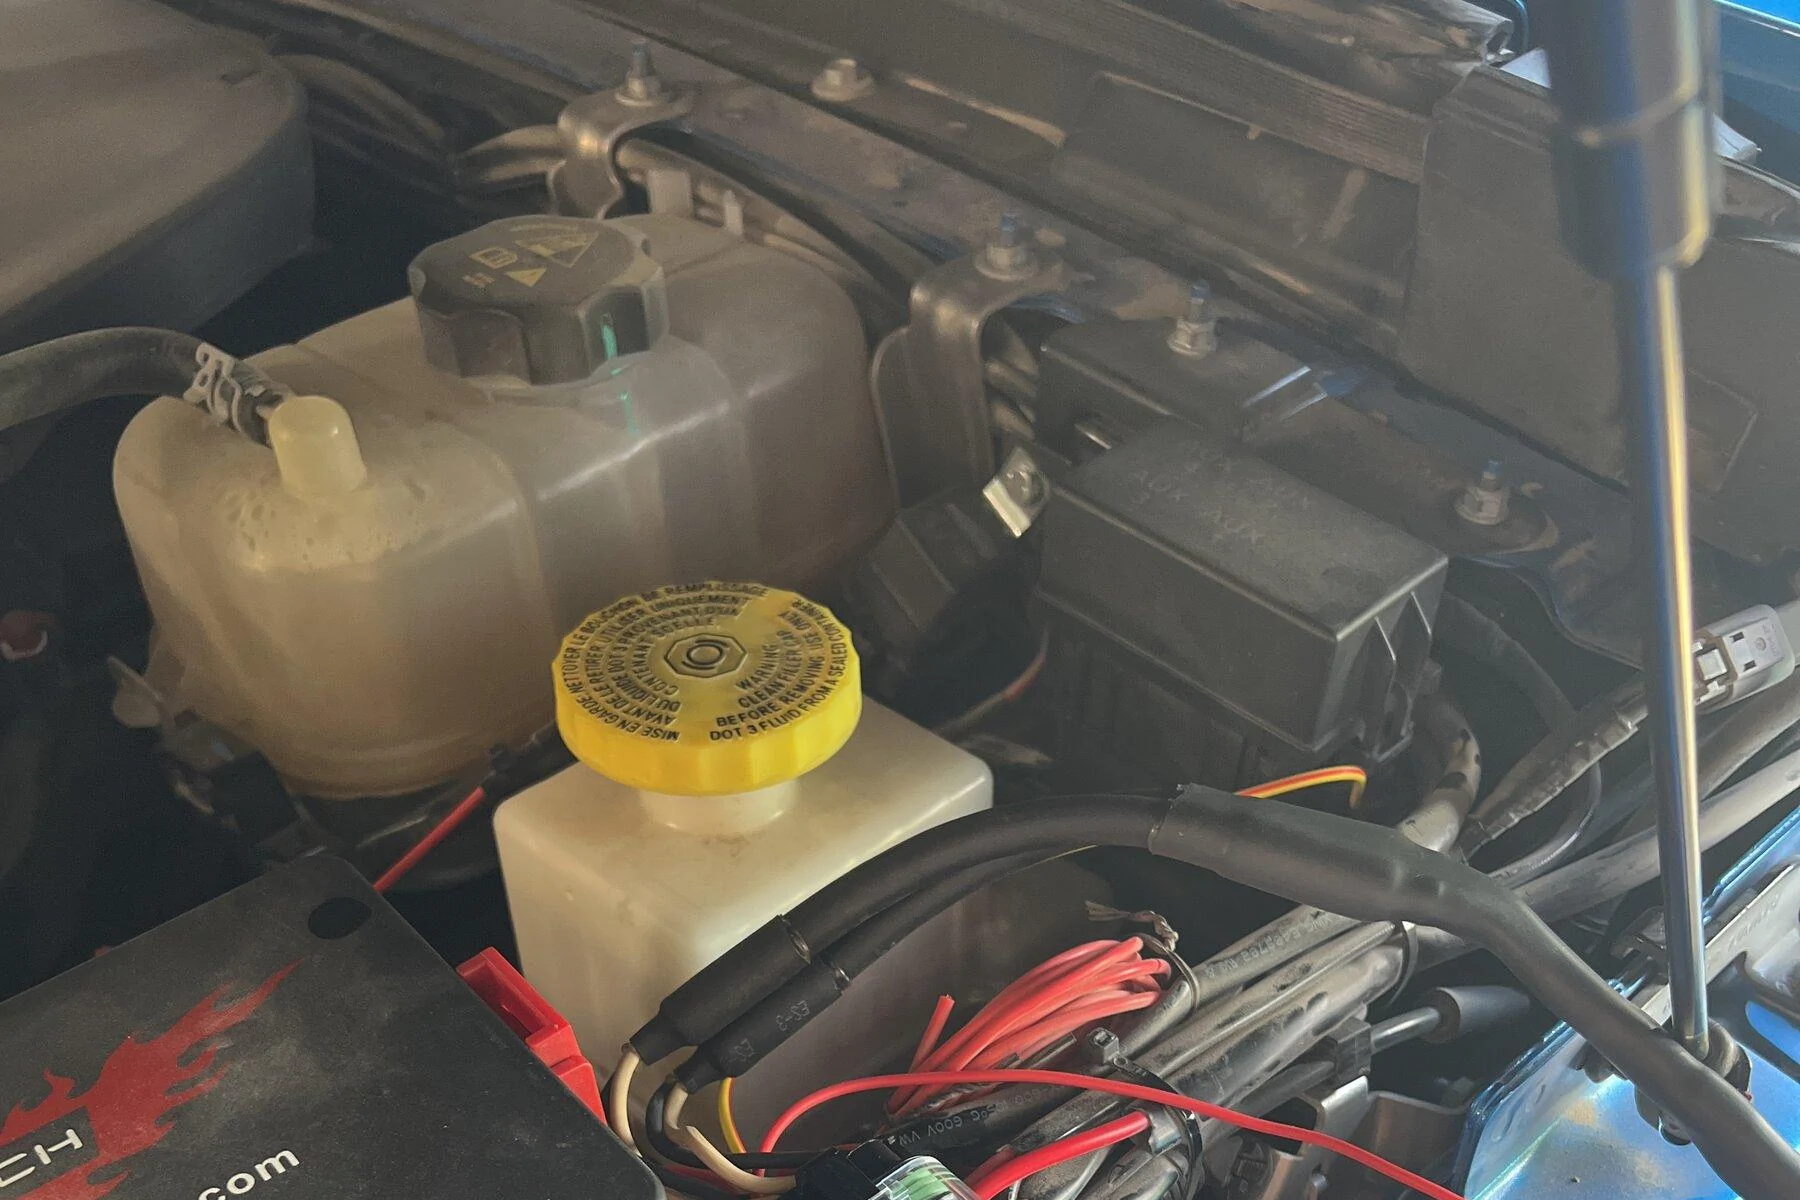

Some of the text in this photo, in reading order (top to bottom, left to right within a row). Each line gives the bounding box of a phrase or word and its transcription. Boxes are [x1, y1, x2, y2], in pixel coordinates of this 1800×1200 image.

[572, 633, 588, 647] LE
[561, 646, 585, 694] NETTOYER
[607, 652, 627, 674] DOT
[631, 636, 680, 697] CONTENANT
[736, 643, 780, 690] WARNING
[611, 673, 660, 706] LIQUIDE
[716, 702, 781, 727] BEFORE
[779, 655, 825, 705] REMOVING
[803, 631, 823, 650] USE
[737, 679, 787, 709] CLEAN
[776, 648, 803, 682] FILLER
[593, 683, 614, 699] LE
[709, 727, 743, 741] DOT
[747, 723, 758, 735] 3
[758, 709, 801, 732] FLUID
[797, 684, 833, 712] FROM
[828, 641, 848, 678] SEALED
[604, 695, 630, 711] DE
[656, 698, 681, 713] DU
[616, 718, 641, 734] EN
[621, 707, 677, 726] AVANT
[640, 725, 680, 741] MISE
[926, 1115, 964, 1137] 600V
